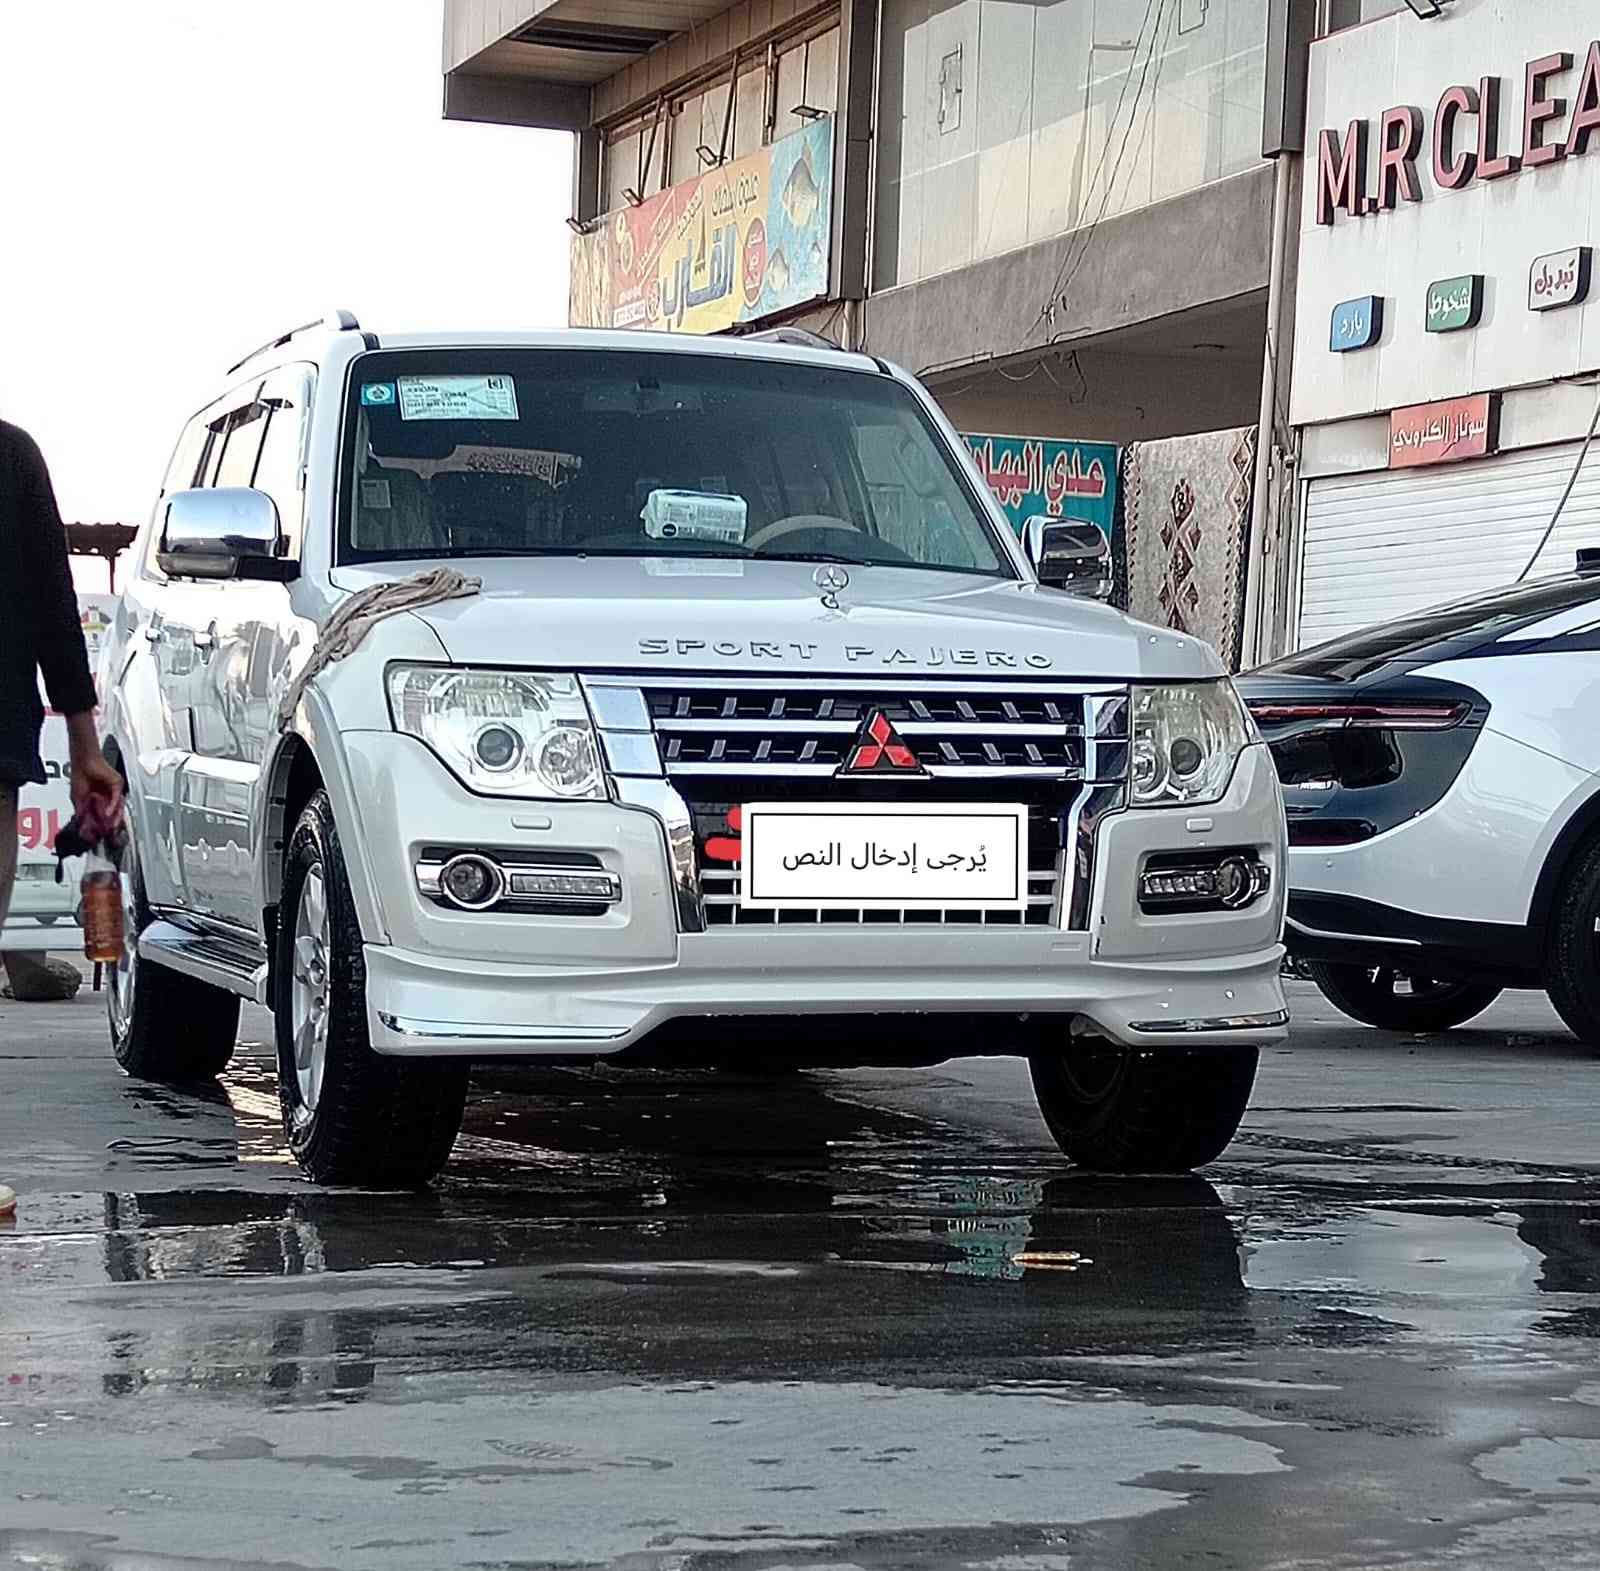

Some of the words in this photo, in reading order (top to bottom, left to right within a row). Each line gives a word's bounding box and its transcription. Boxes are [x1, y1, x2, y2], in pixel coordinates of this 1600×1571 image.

[1340, 310, 1363, 339] بارد
[638, 638, 818, 660] SPORT
[844, 645, 1054, 670] PAJERO
